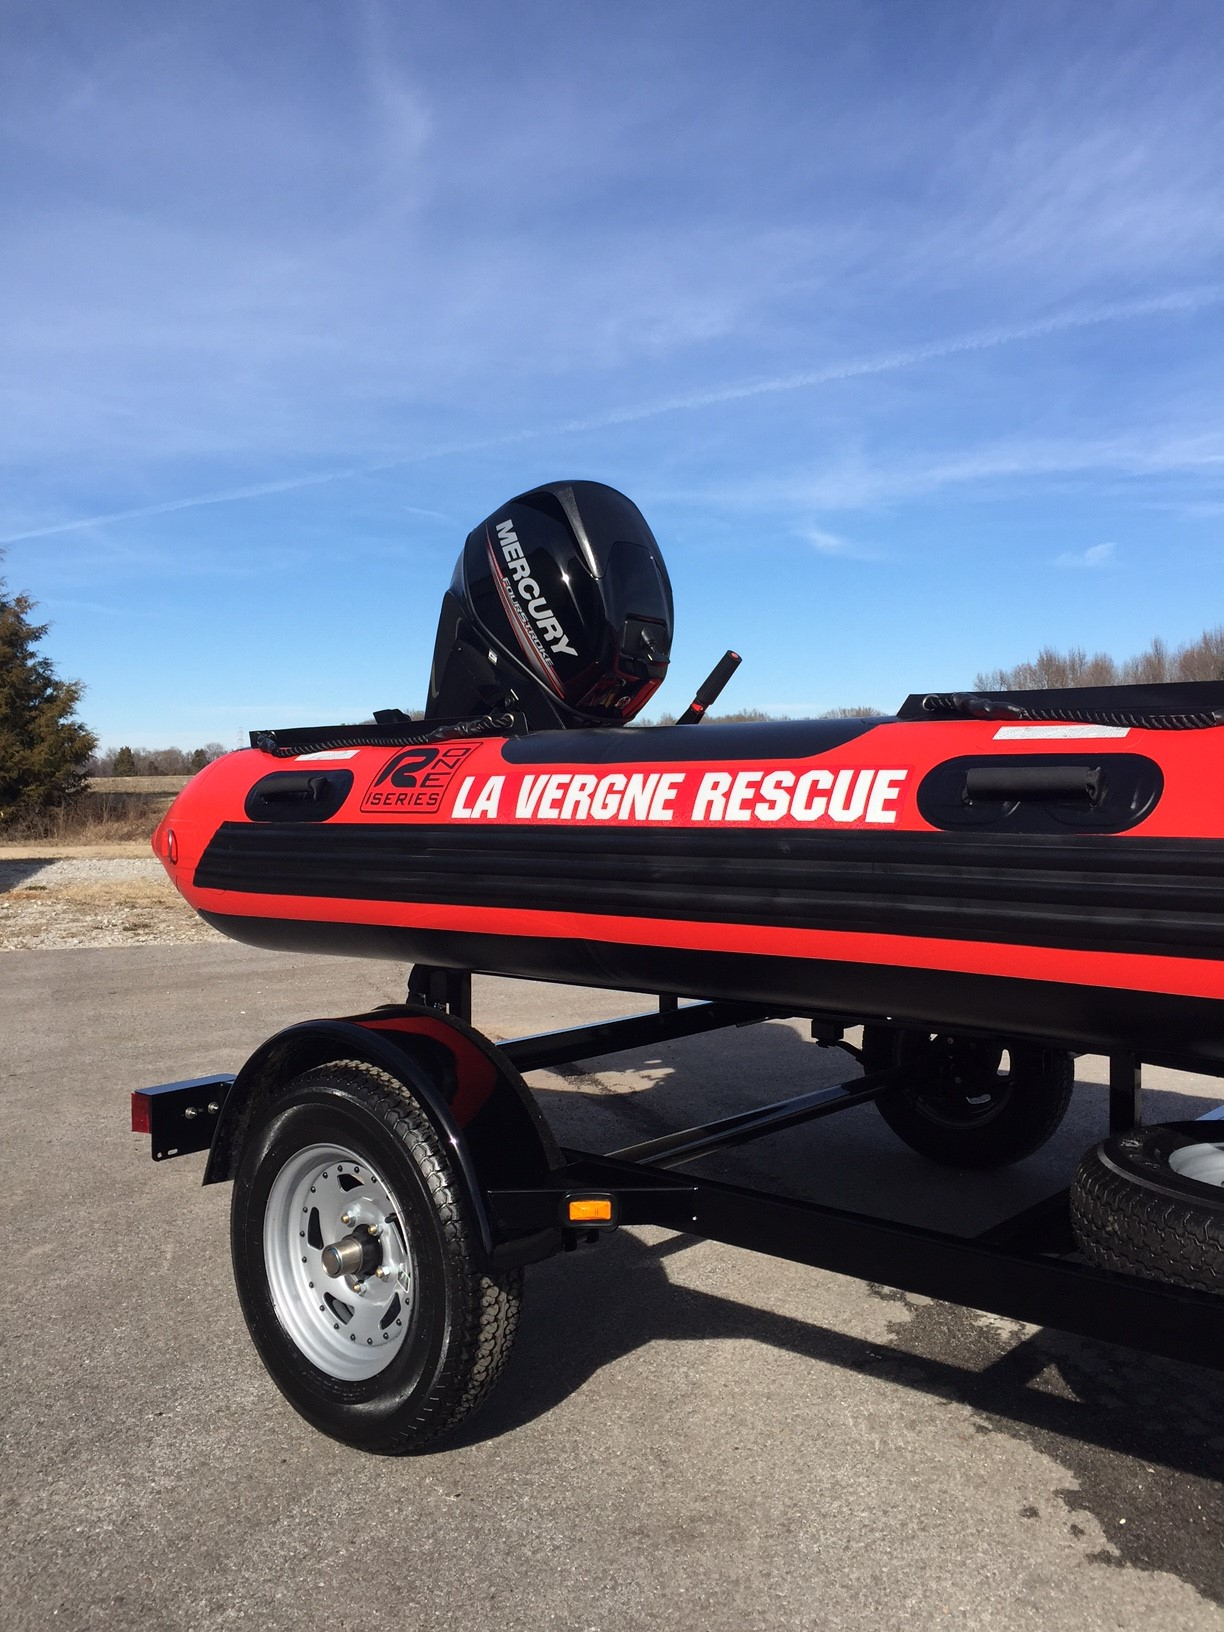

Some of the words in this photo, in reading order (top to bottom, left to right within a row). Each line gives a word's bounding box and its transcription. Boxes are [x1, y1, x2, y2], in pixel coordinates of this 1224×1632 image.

[496, 519, 579, 657] MERCURY
[502, 577, 555, 667] FOURSTROKE
[452, 776, 505, 818] LA
[516, 773, 685, 820] VERGNE
[692, 770, 907, 823] RESCUE
